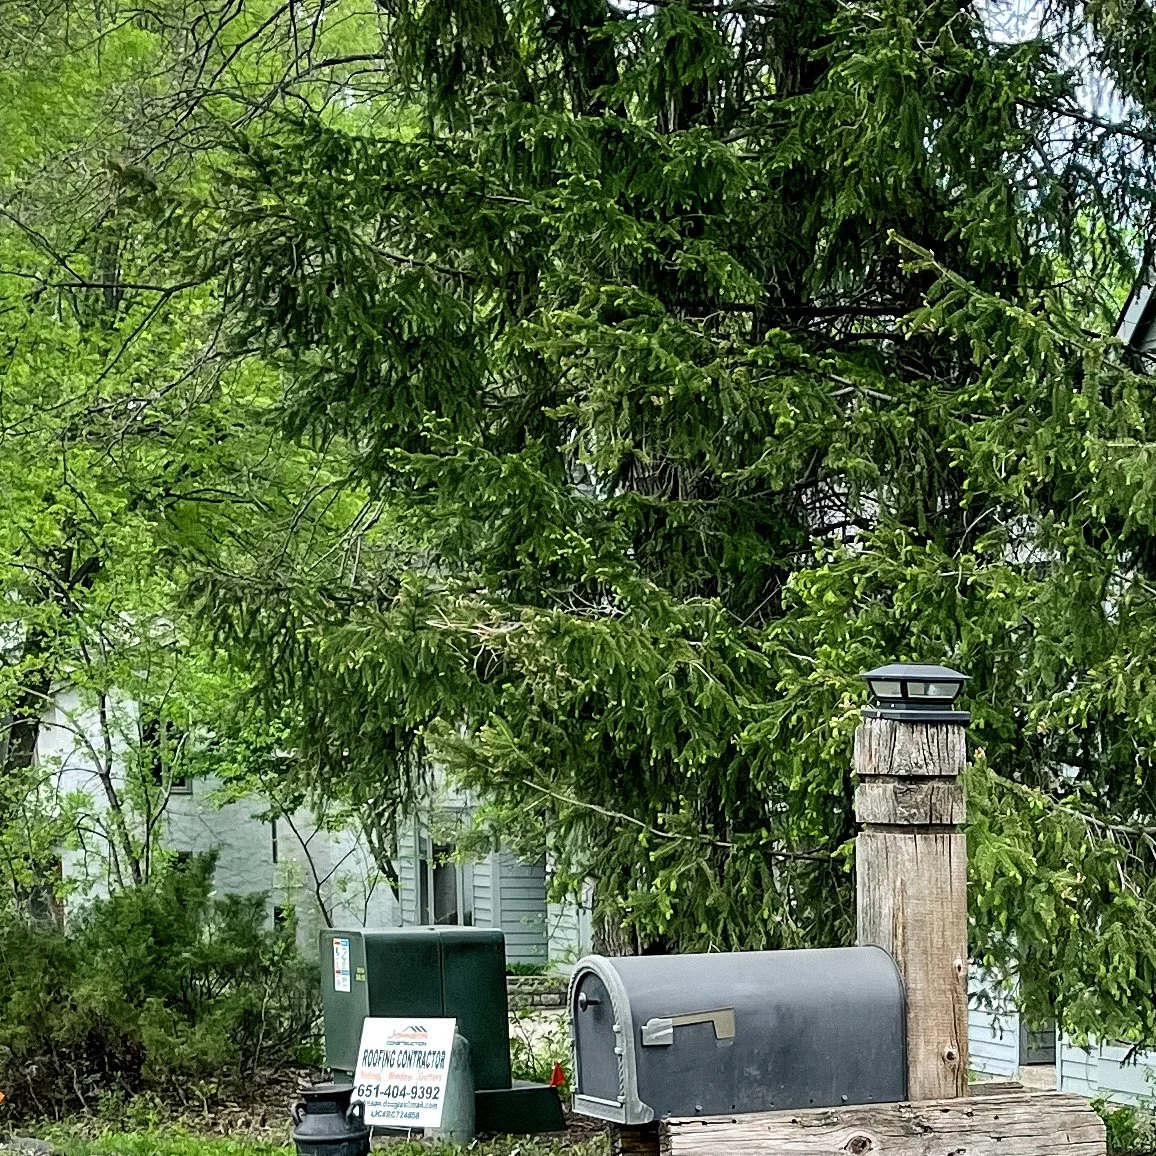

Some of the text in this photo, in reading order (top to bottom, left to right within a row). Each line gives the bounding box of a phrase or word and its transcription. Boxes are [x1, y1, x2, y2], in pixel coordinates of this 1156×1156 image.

[362, 1049, 446, 1070] ROOFING CONTRACTOR
[357, 1083, 441, 1100] 651-404-9392
